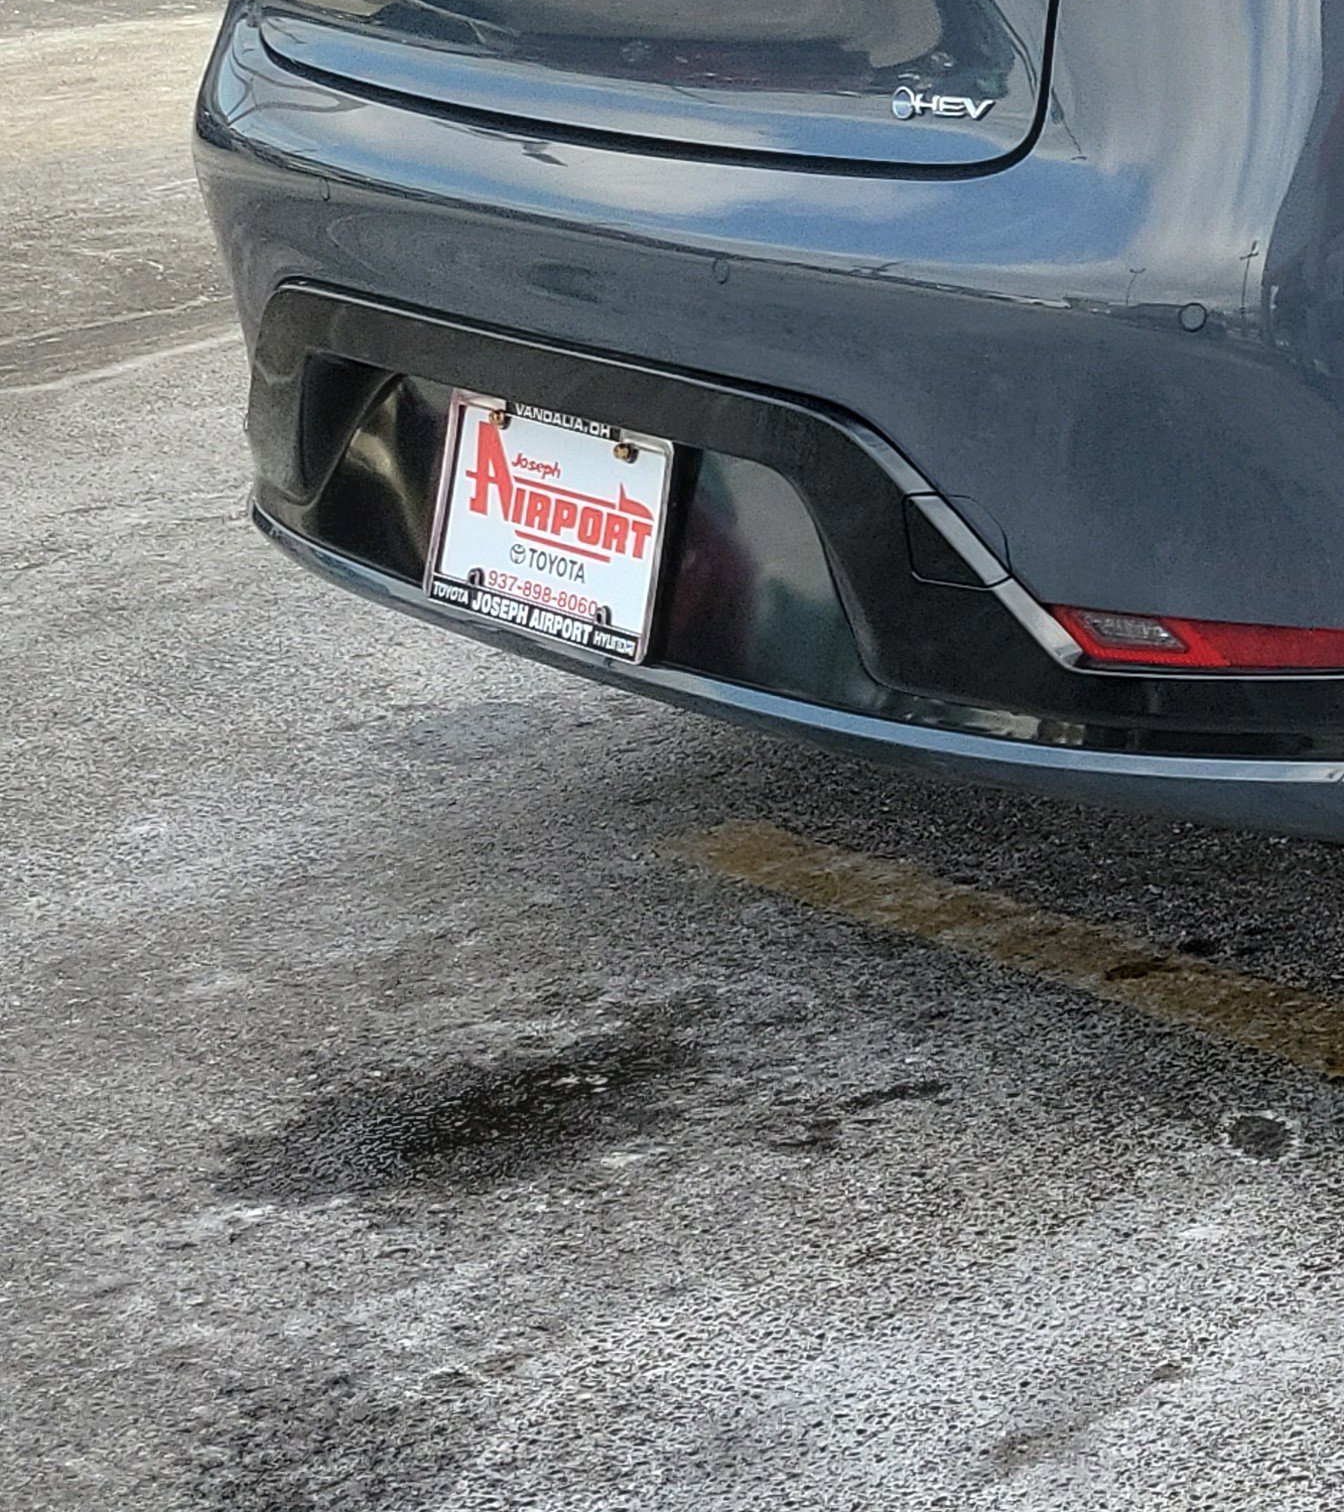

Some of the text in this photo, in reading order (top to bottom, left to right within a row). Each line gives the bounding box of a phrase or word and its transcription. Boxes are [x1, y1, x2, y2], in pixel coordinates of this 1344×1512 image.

[914, 93, 996, 120] HEV
[511, 453, 562, 480] Joseph
[465, 420, 654, 560] AIRPORT
[528, 547, 586, 584] TOYOTA
[433, 581, 469, 605] TOYOTA
[471, 592, 529, 626] JOSEPH
[529, 609, 593, 646] AIRPORT
[487, 570, 598, 616] 937-898-8060
